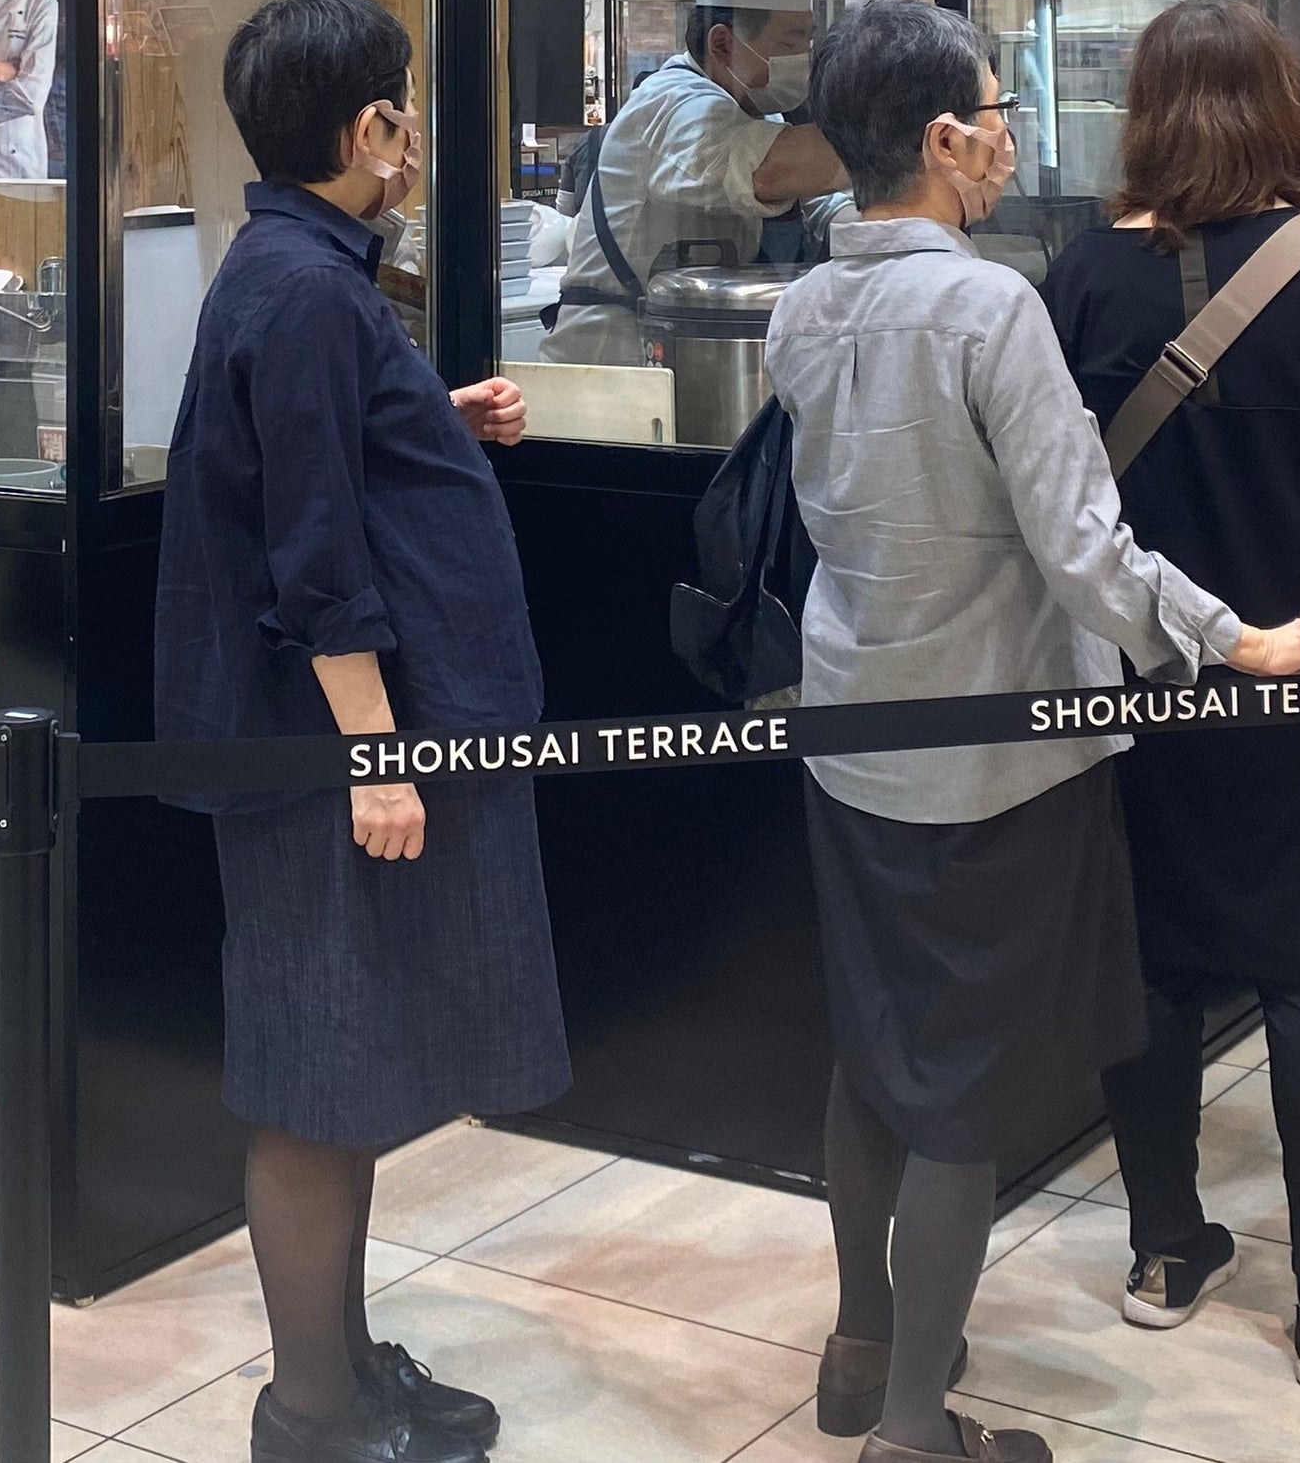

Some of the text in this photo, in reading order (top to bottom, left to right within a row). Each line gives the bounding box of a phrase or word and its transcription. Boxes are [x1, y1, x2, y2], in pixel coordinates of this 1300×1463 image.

[1030, 686, 1239, 732] SHOKUSAI
[349, 718, 790, 778] SHOKUSAI TERRACE
